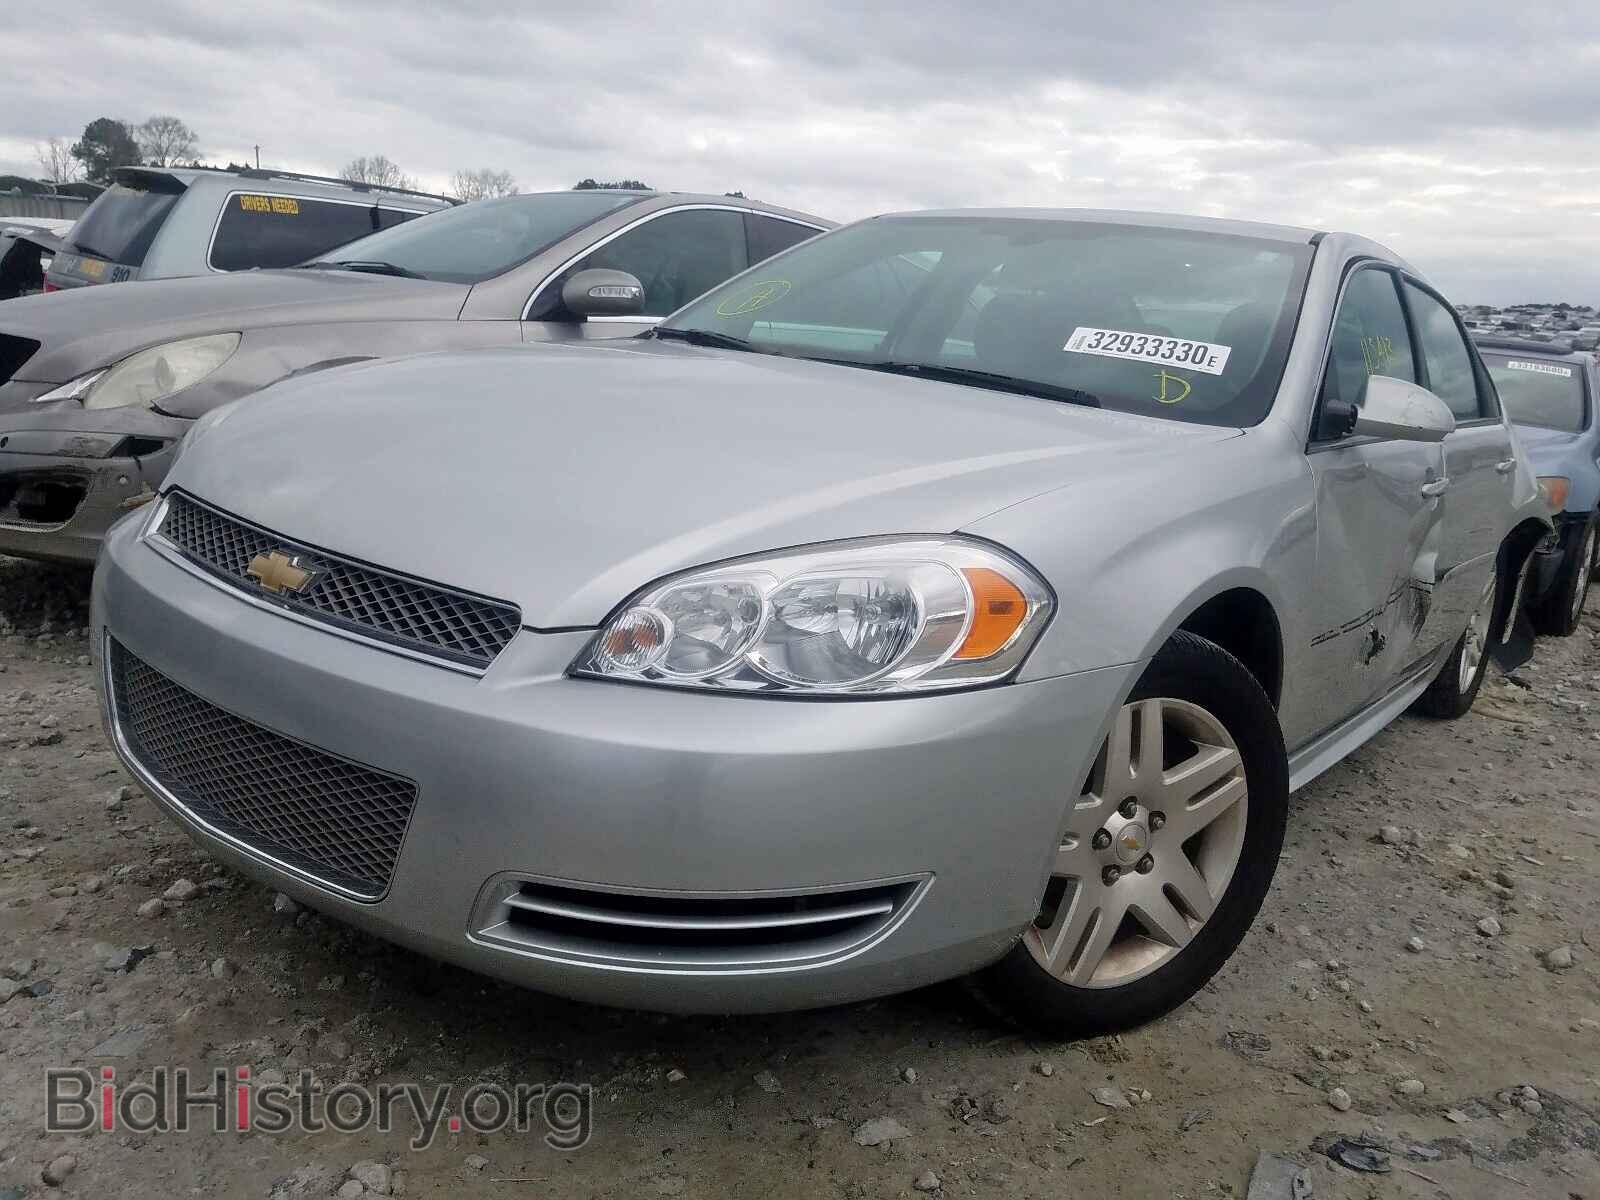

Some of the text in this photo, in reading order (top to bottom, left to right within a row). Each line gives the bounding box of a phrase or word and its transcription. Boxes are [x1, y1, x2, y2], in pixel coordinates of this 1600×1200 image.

[240, 195, 299, 215] DRIVERS NEEDED
[1087, 331, 1209, 365] 32933330
[1207, 355, 1219, 368] E
[1152, 369, 1191, 404] D
